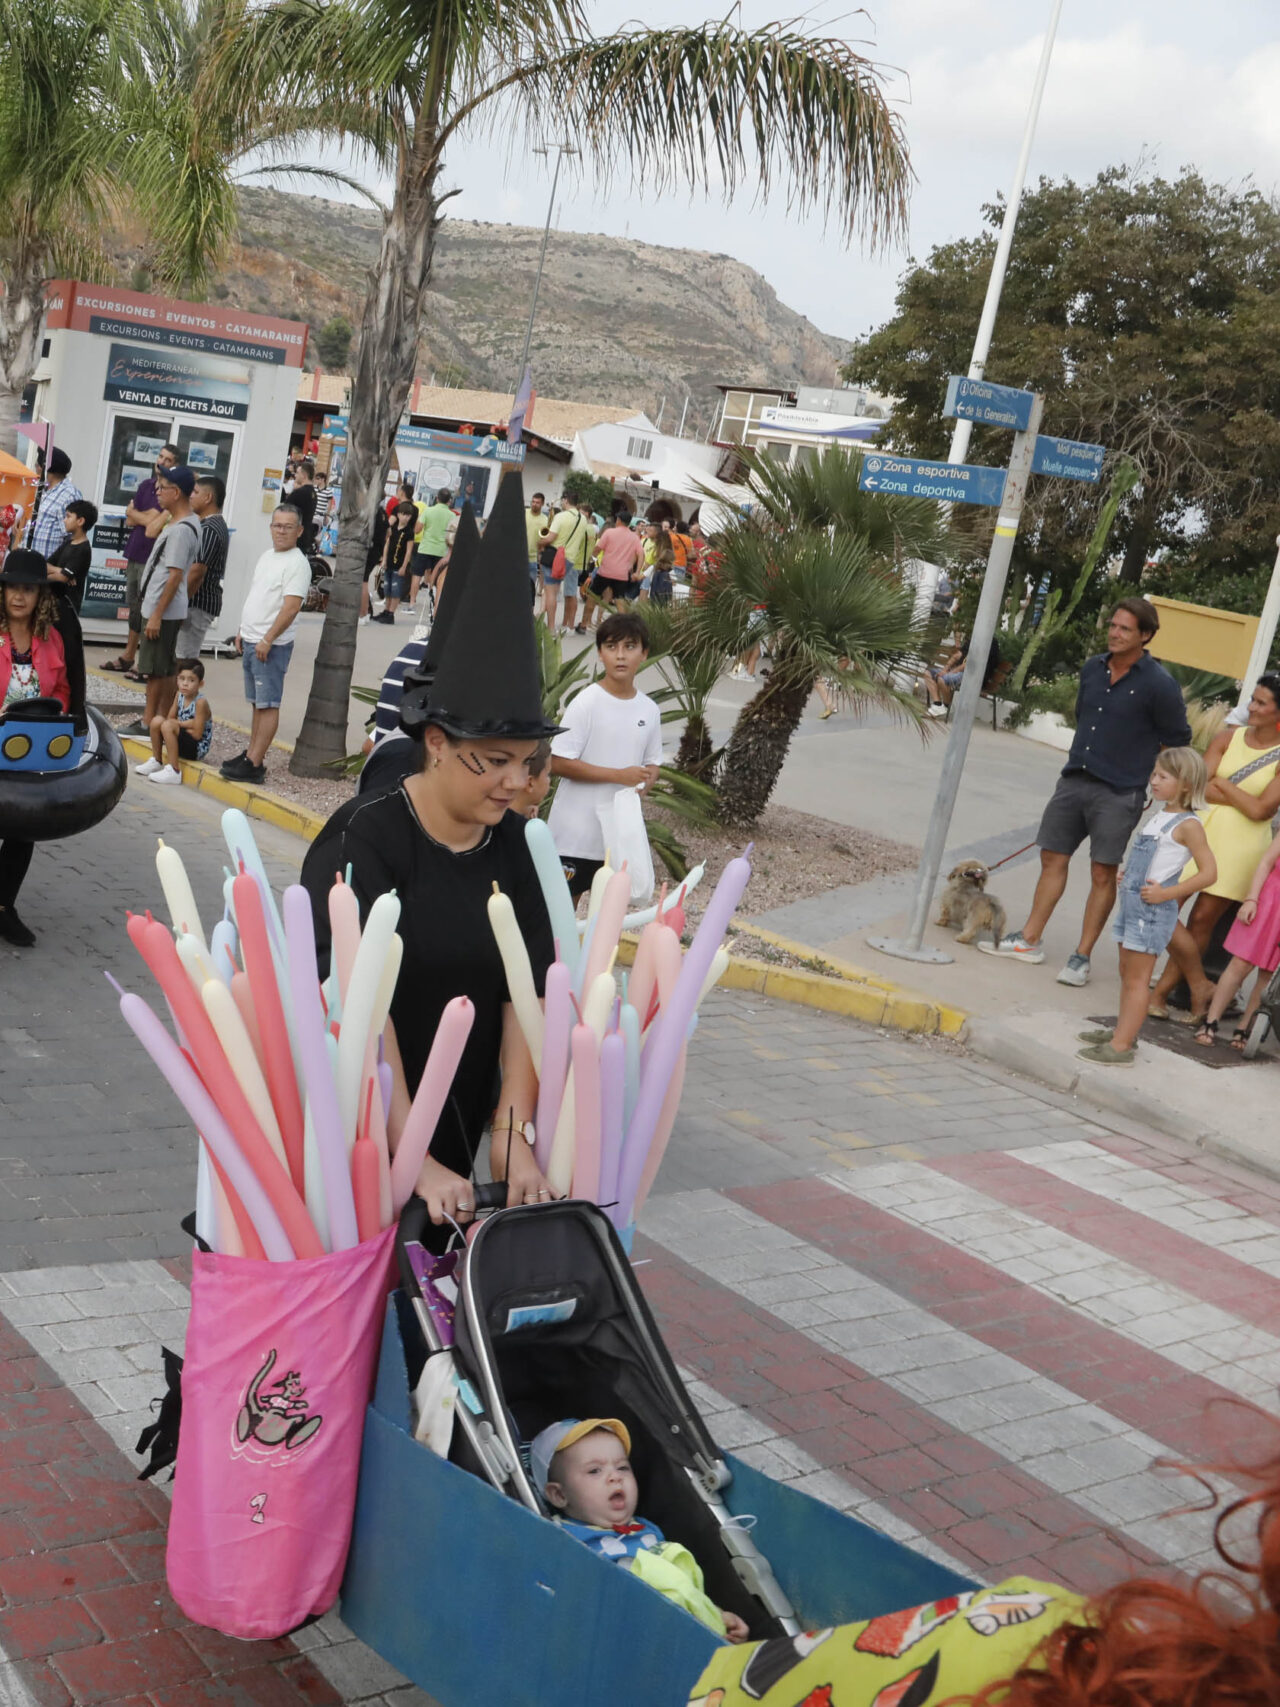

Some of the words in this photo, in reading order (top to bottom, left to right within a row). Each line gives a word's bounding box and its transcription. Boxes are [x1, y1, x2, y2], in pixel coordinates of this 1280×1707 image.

[76, 296, 156, 319] EXCURSIONES
[166, 312, 216, 329] EVENTOS
[226, 323, 303, 345] CATAMARANES
[99, 322, 161, 341] EXCURSIONS
[169, 334, 205, 348] EVENTS
[213, 342, 274, 360] CATAMARANS
[132, 357, 200, 376] MEDITERRANEAN
[969, 381, 992, 399] Oficina
[118, 389, 151, 405] VENTA
[153, 394, 167, 406] DE
[170, 397, 208, 412] TICKETS
[210, 403, 235, 416] AQUÍ
[965, 405, 974, 417] de
[975, 408, 982, 418] la
[984, 407, 1018, 425] Generalitat
[1056, 442, 1070, 455] Moll
[1072, 446, 1094, 461] pesquer
[883, 460, 912, 473] Zona
[917, 464, 970, 481] esportiva
[1042, 459, 1062, 474] Muelle
[1063, 464, 1092, 479] pesquero
[879, 478, 908, 492] Zona
[913, 483, 966, 499] deportiva
[88, 591, 124, 600] ATARDECER
[89, 582, 117, 591] PUESTA
